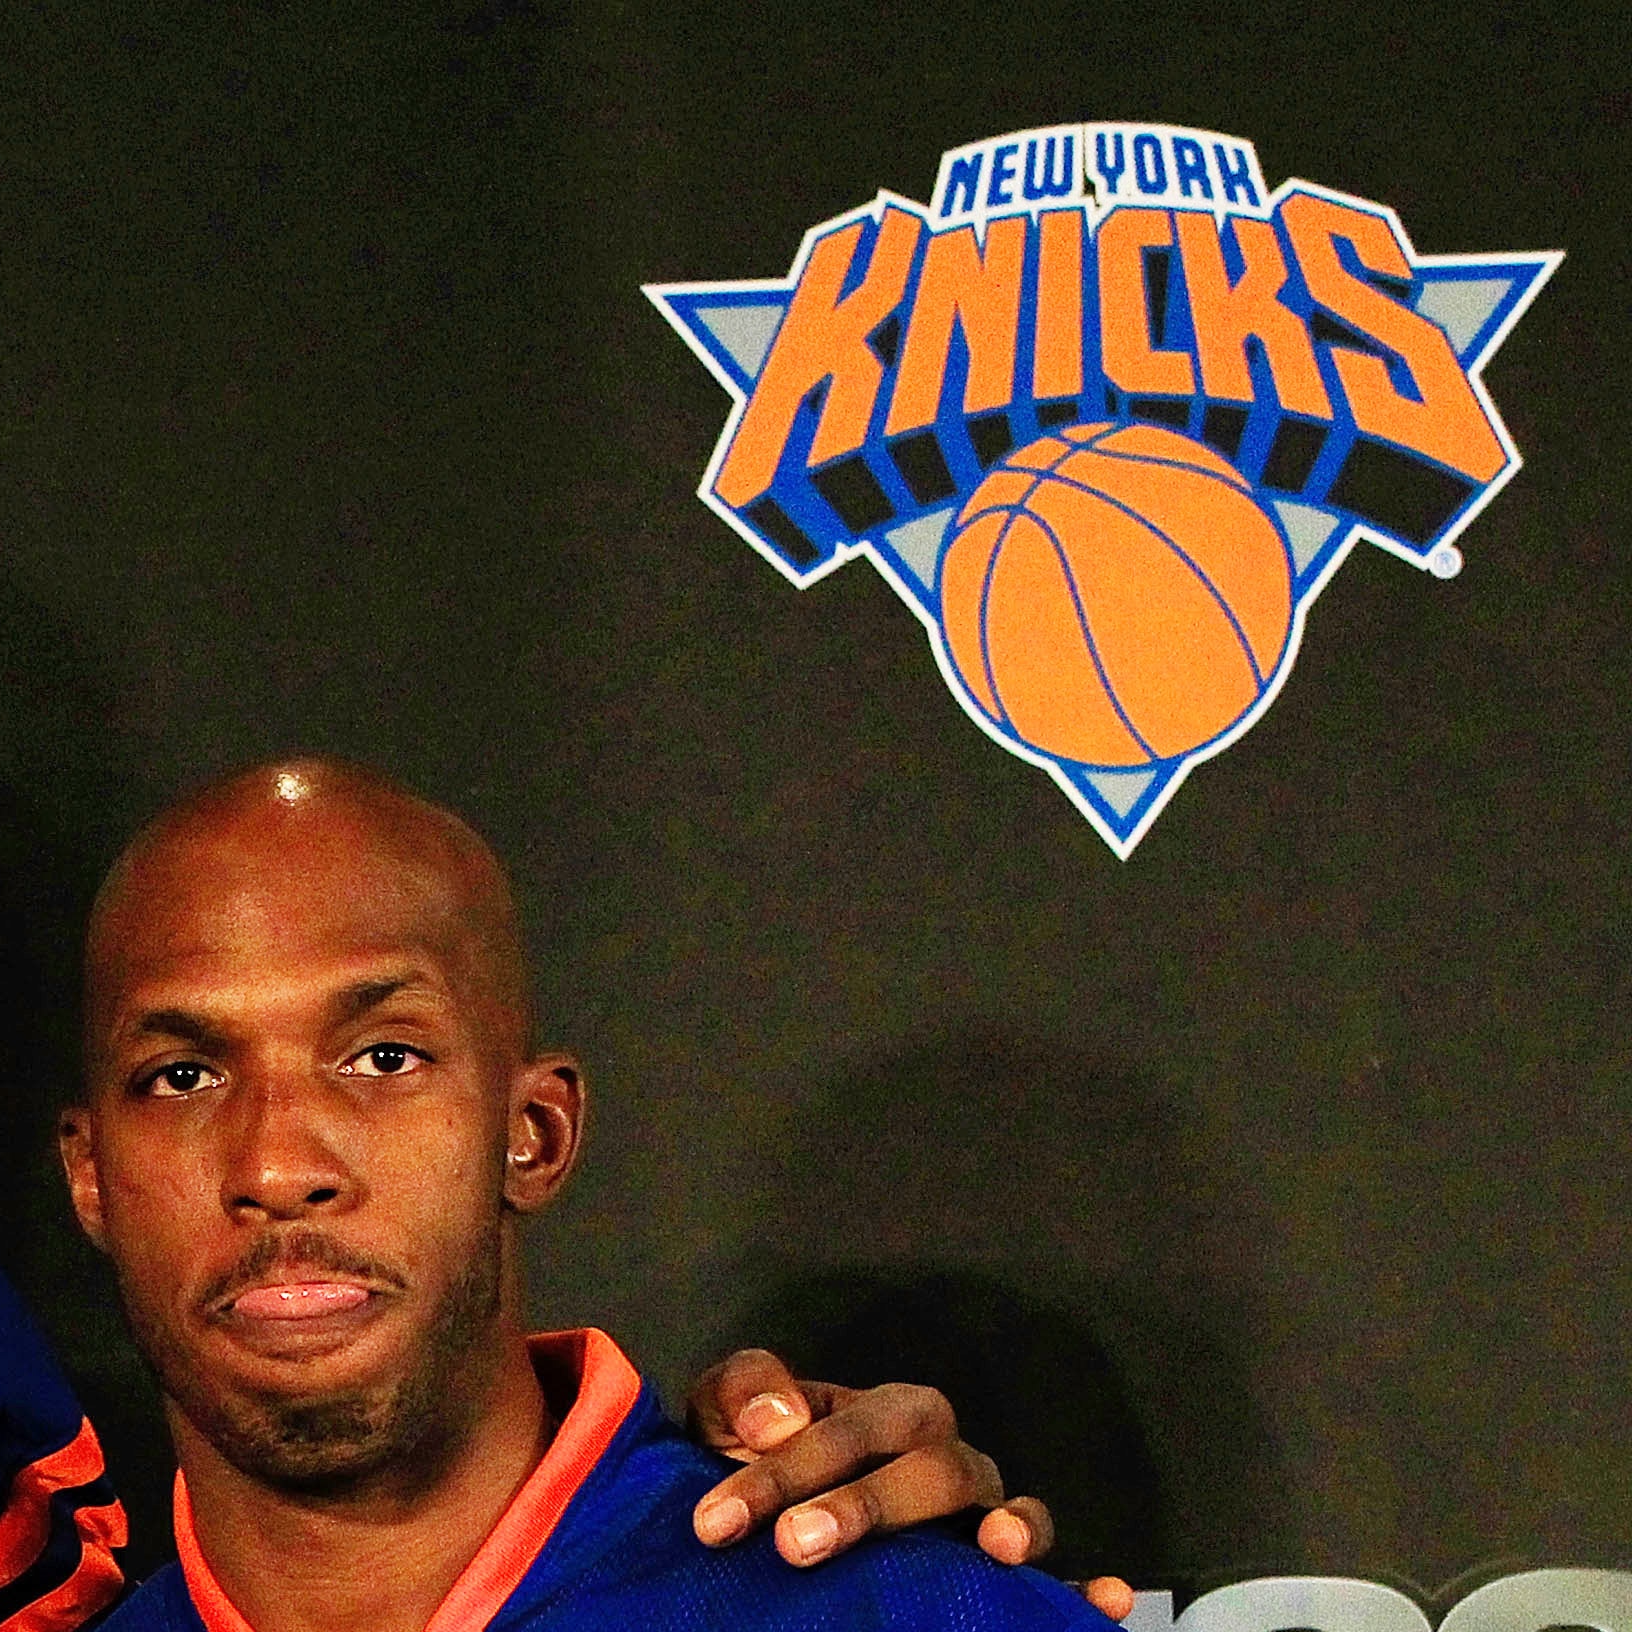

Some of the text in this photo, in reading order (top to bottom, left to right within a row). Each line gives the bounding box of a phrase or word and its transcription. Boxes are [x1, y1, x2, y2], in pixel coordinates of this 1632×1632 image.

[939, 132, 1262, 218] NEW YORK
[711, 191, 1513, 512] KNICKS
